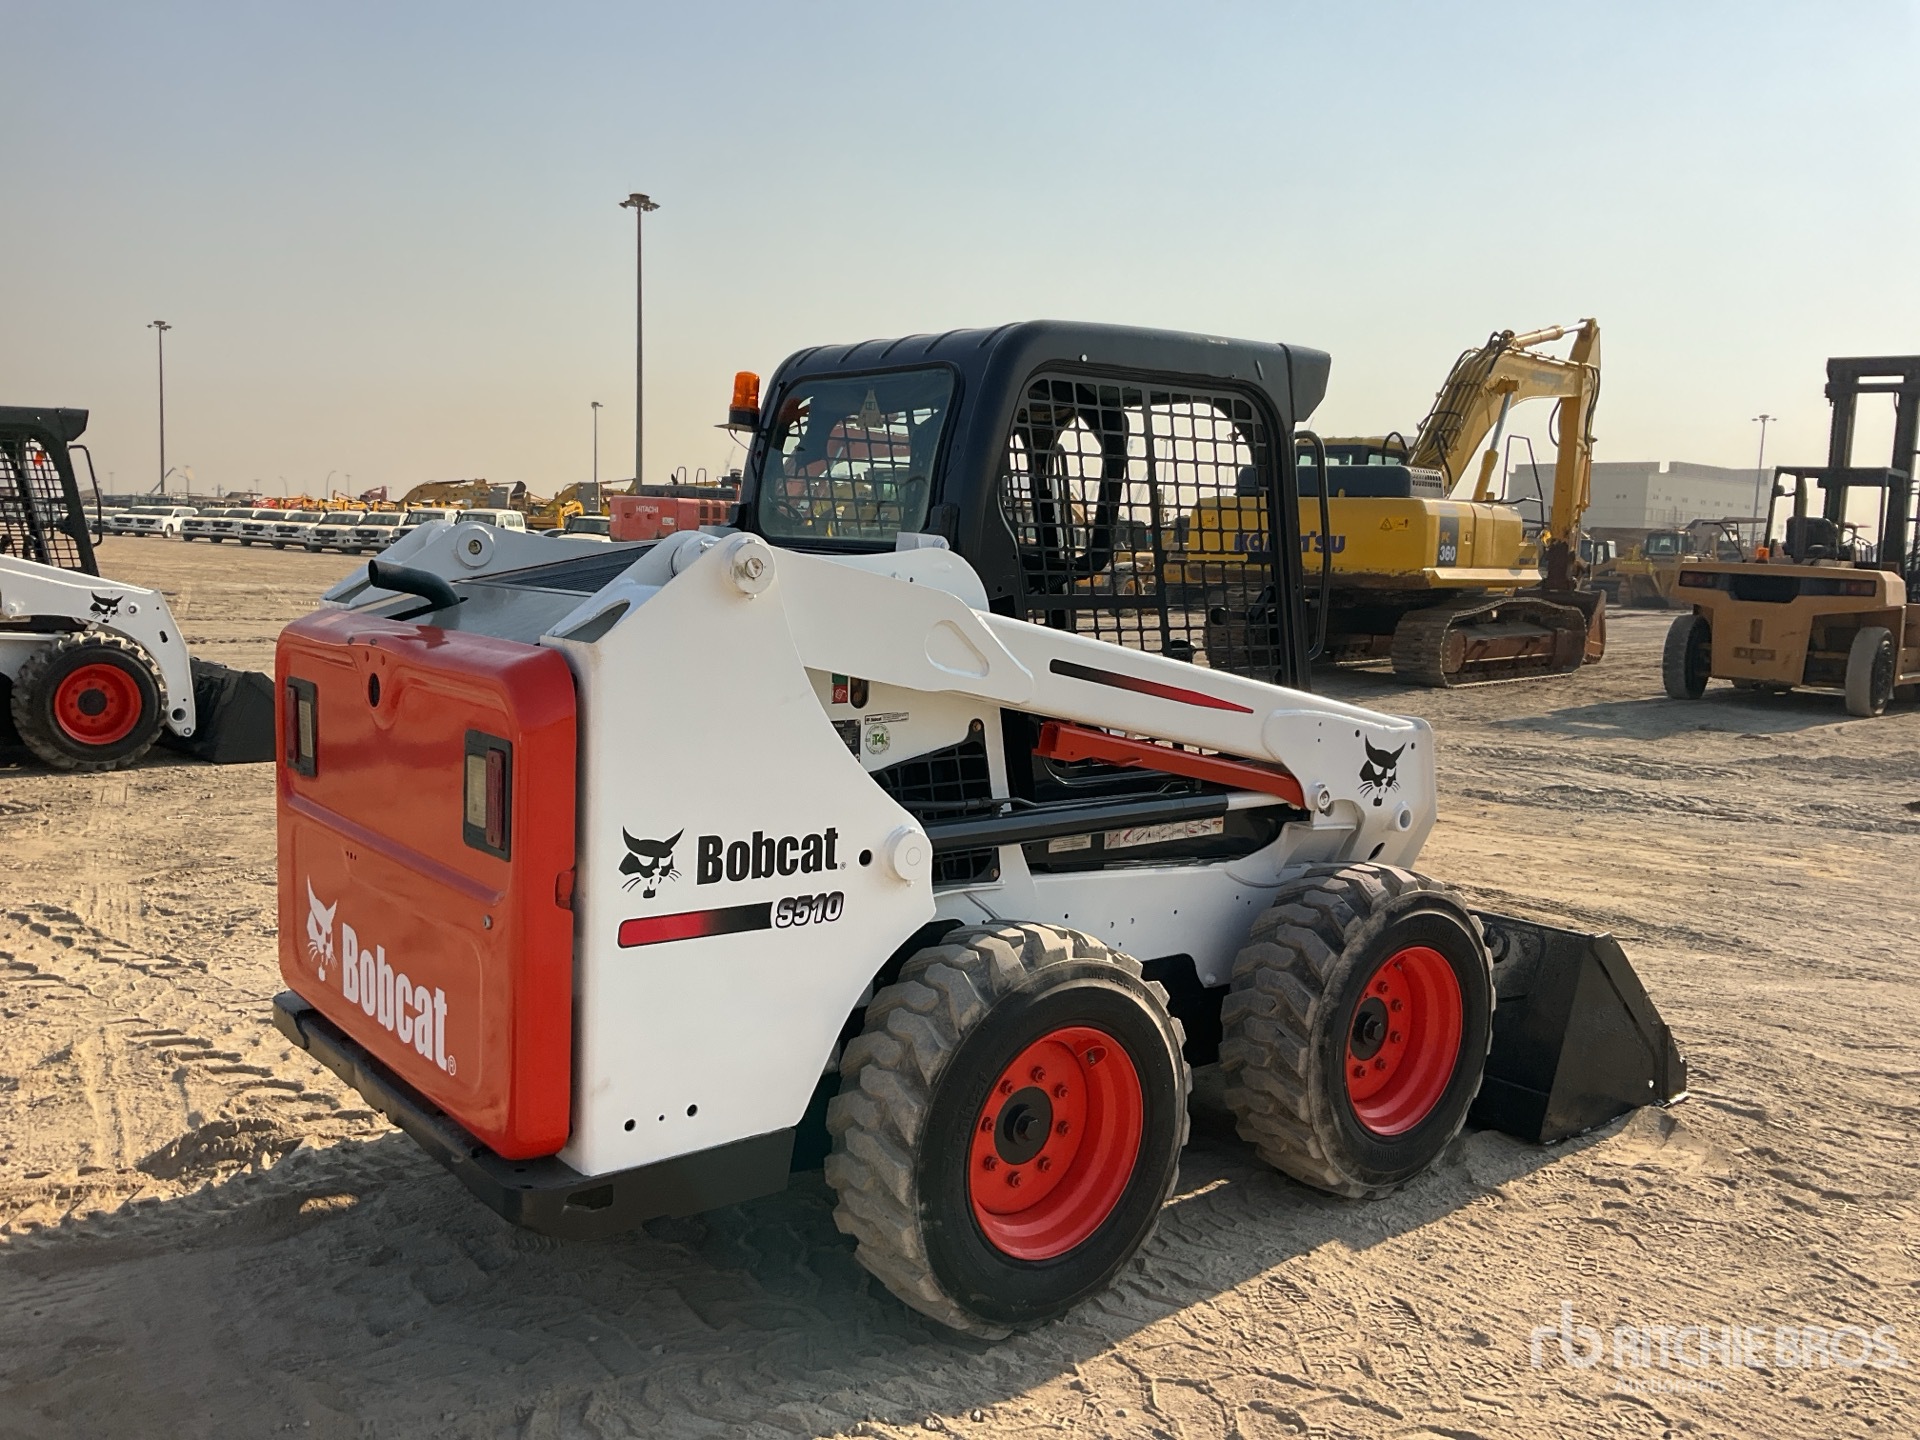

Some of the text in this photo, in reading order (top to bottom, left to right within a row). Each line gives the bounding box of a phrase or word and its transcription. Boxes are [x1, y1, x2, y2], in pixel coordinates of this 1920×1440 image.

[635, 505, 659, 513] HITACHI
[1439, 545, 1456, 561] 360
[696, 827, 839, 886] Bobcat
[775, 891, 844, 929] S510
[342, 922, 448, 1071] Bobcat
